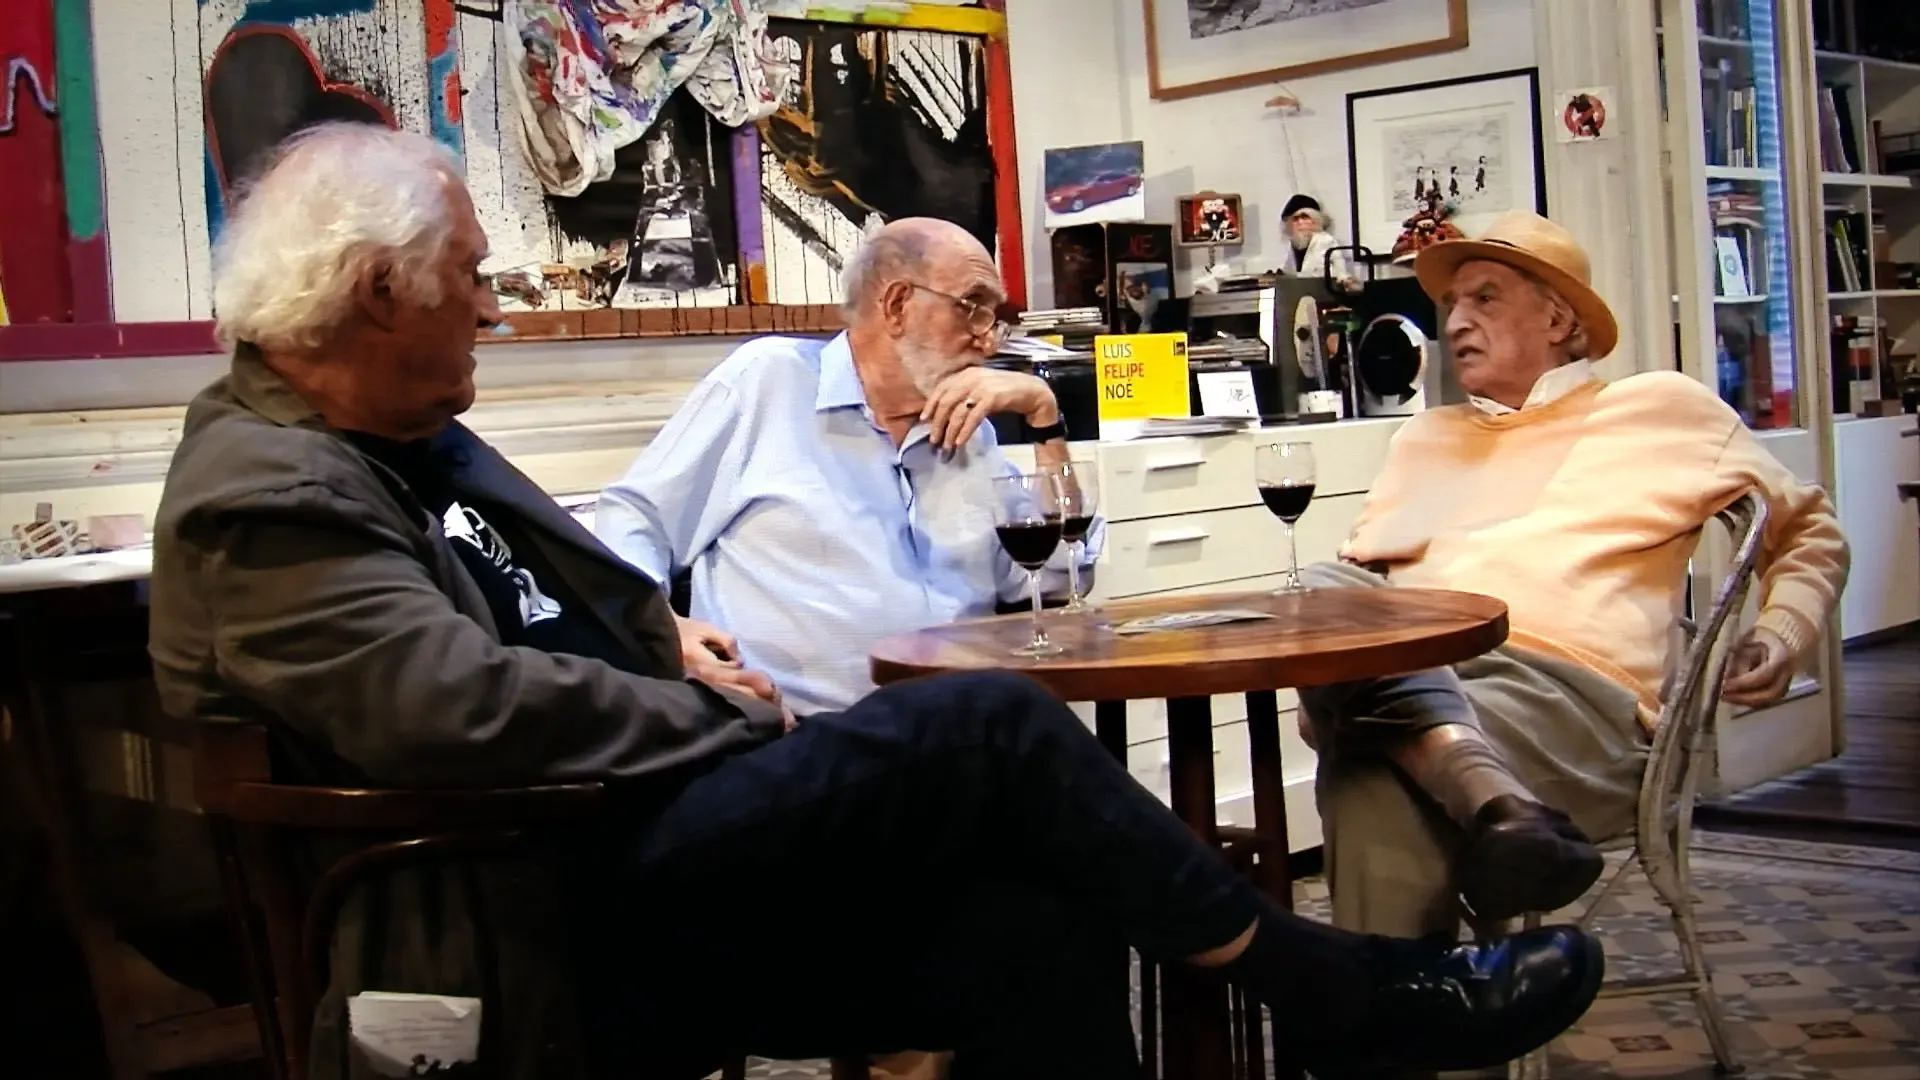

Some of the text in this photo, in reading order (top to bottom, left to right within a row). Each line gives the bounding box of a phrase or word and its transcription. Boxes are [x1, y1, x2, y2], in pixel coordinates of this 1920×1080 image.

[1103, 343, 1132, 359] LUIS
[1104, 363, 1145, 379] FELIPE
[1105, 379, 1134, 400] NOÉ
